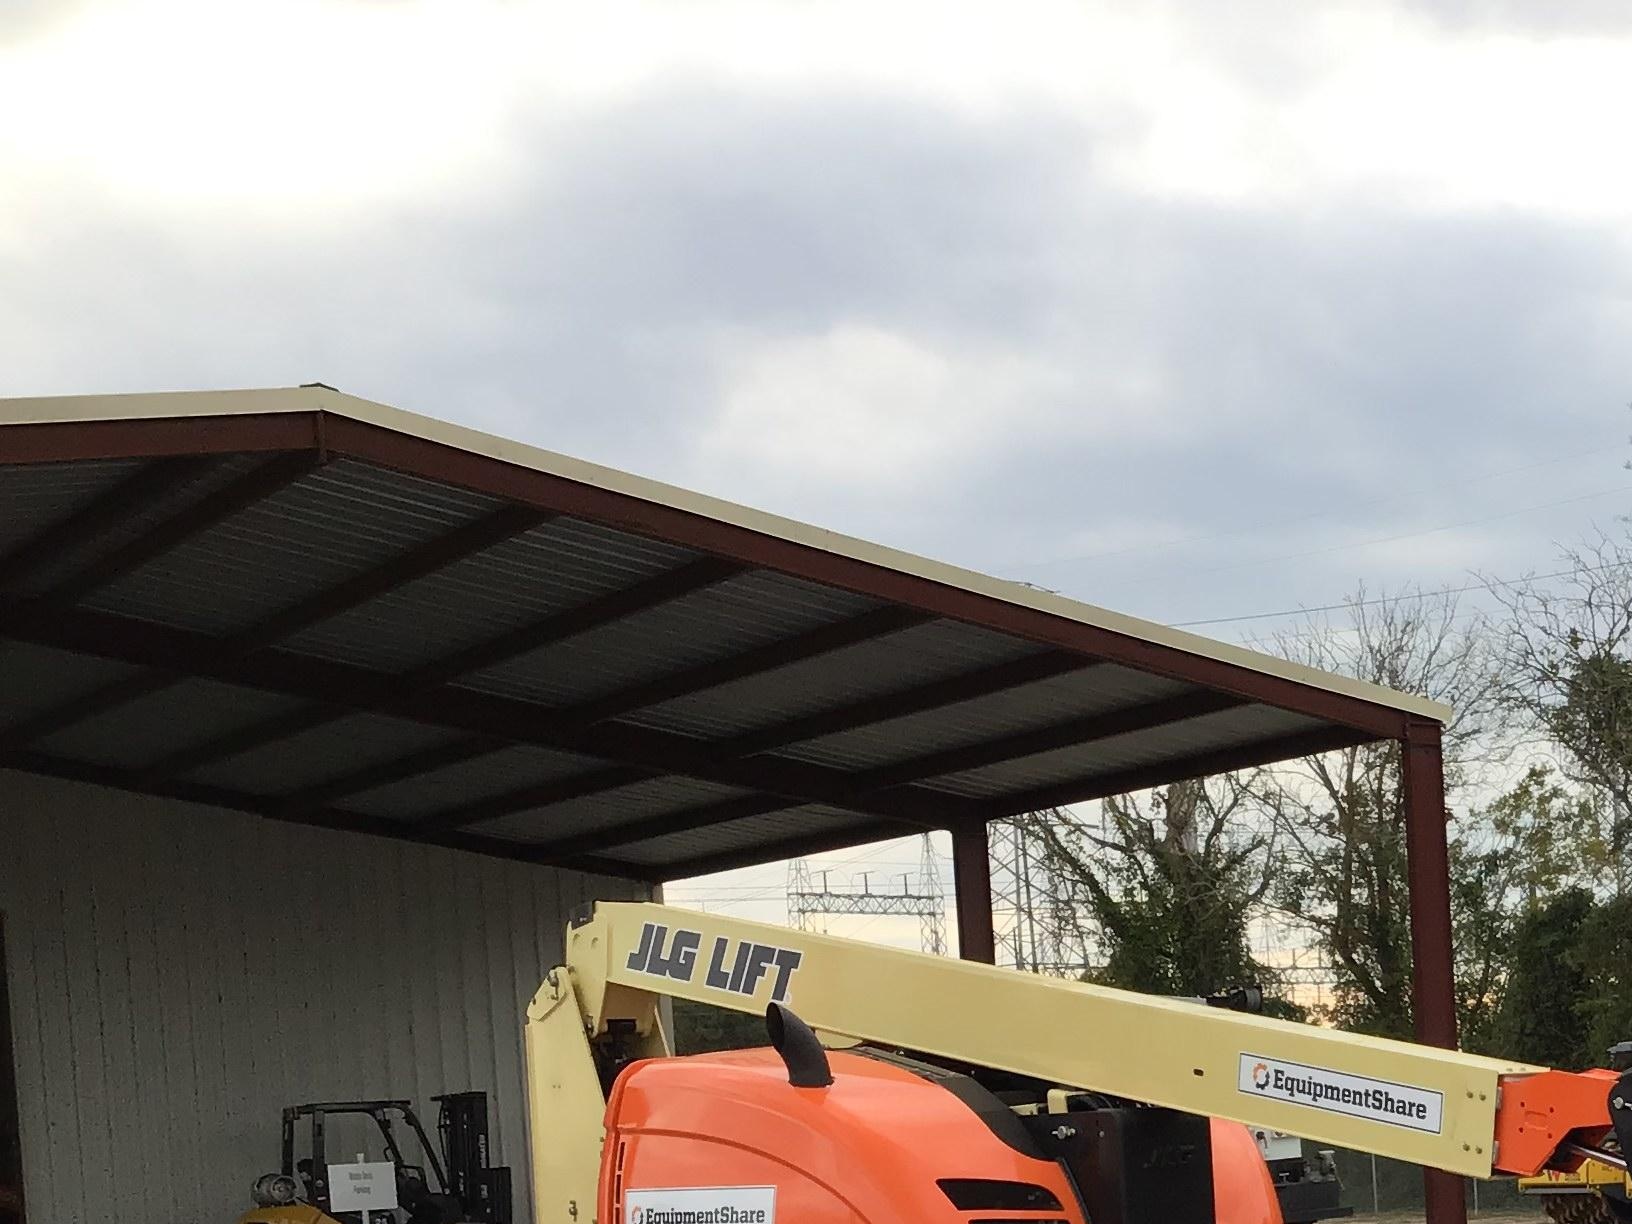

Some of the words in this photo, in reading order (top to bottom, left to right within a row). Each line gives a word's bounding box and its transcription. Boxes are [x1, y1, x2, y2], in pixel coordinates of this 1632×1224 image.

[626, 922, 702, 982] JLG
[704, 936, 802, 1003] LIFT
[1272, 1068, 1427, 1121] EquipmentShare
